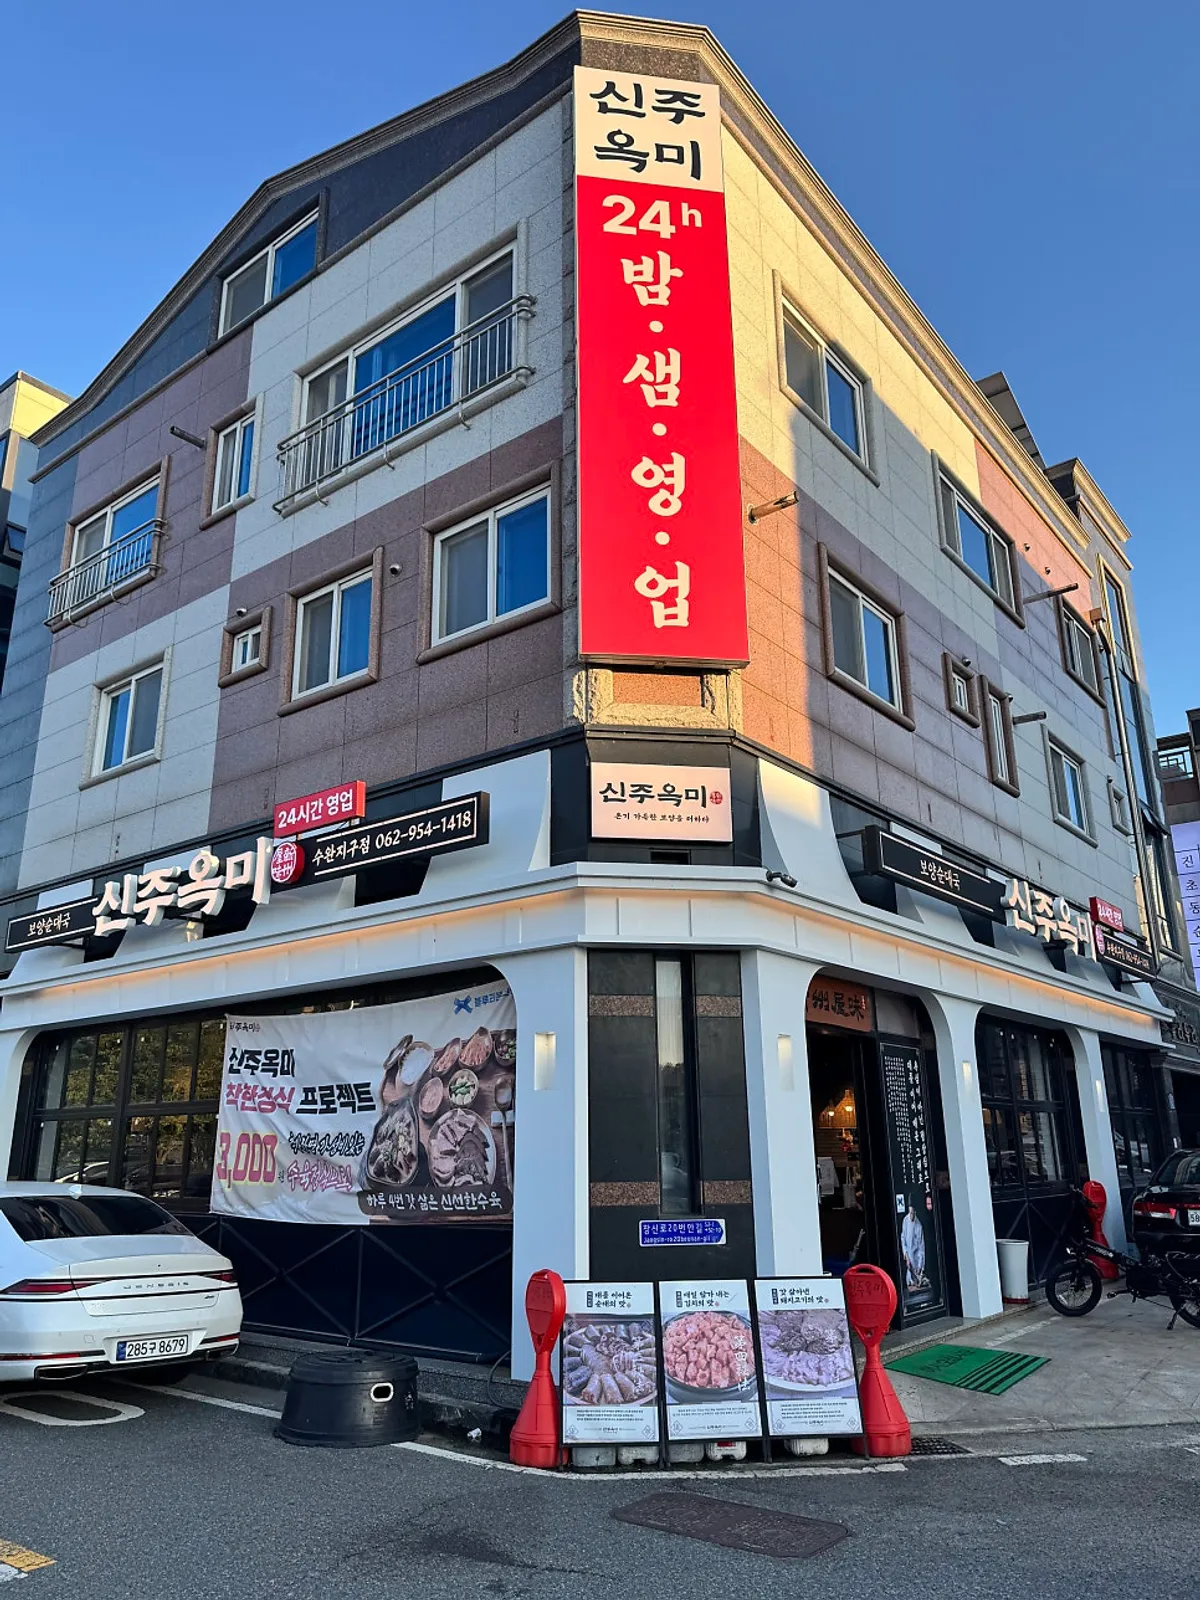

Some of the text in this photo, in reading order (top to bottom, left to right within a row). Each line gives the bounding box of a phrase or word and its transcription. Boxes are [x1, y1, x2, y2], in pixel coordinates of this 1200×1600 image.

[589, 80, 706, 125] 신주
[594, 128, 701, 181] 옥미
[602, 194, 703, 240] 24h
[278, 789, 353, 829] 24시간 영업
[599, 781, 707, 809] 신주옥미
[312, 834, 370, 867] 수완지구점
[375, 810, 472, 849] 062-954-1418
[92, 836, 274, 937] 신주옥미
[920, 860, 960, 891] 보양순대국
[27, 912, 71, 937] 보양순대국
[1001, 879, 1097, 963] 신주옥미
[228, 1047, 296, 1078] 신주옥미
[226, 1082, 377, 1115] 착한정식 프로젝트
[366, 1192, 387, 1210] 하루
[127, 1338, 185, 1358] 285구 8679
